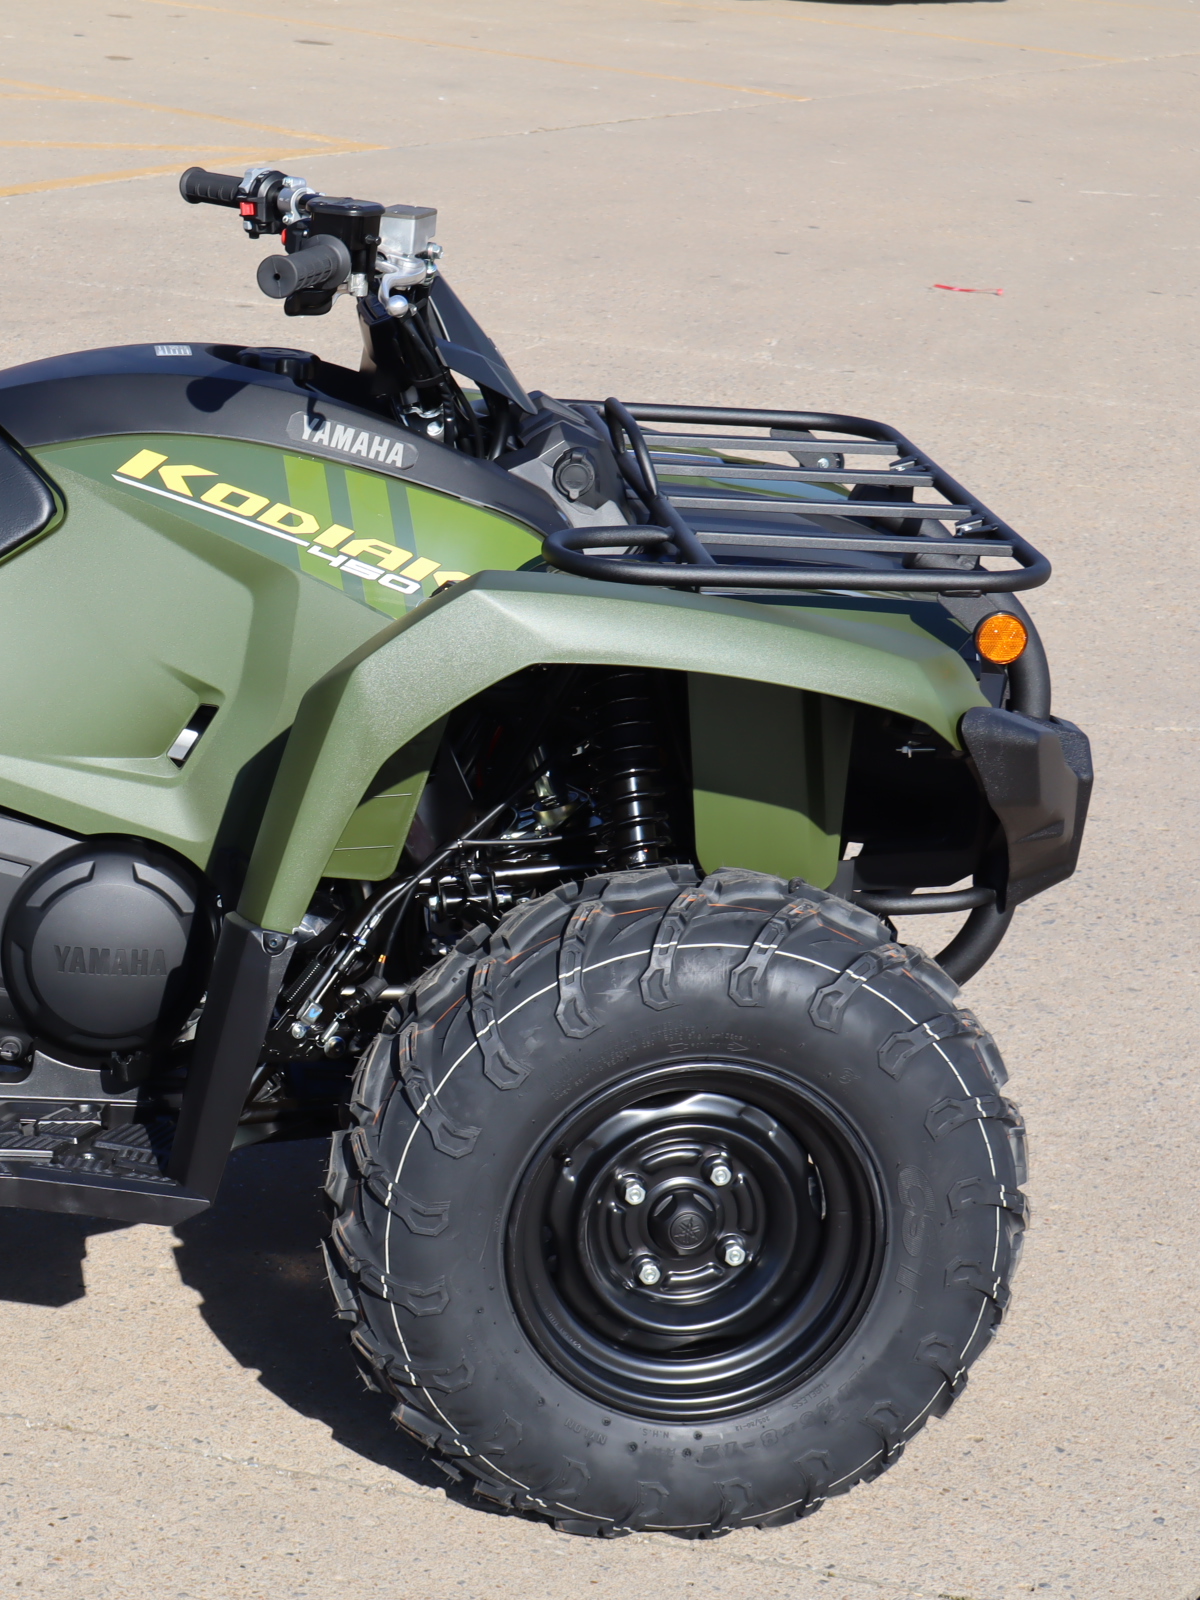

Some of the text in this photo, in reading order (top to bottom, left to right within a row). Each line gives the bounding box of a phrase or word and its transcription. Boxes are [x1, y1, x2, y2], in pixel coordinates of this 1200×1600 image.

[301, 414, 404, 468] YAMAHA
[307, 545, 421, 595] 450
[53, 945, 167, 977] YAMAHA
[896, 1165, 937, 1310] CST
[788, 1378, 831, 1411] TUBELESS
[561, 1415, 608, 1446] NYLON
[636, 1425, 669, 1440] N.H.S.
